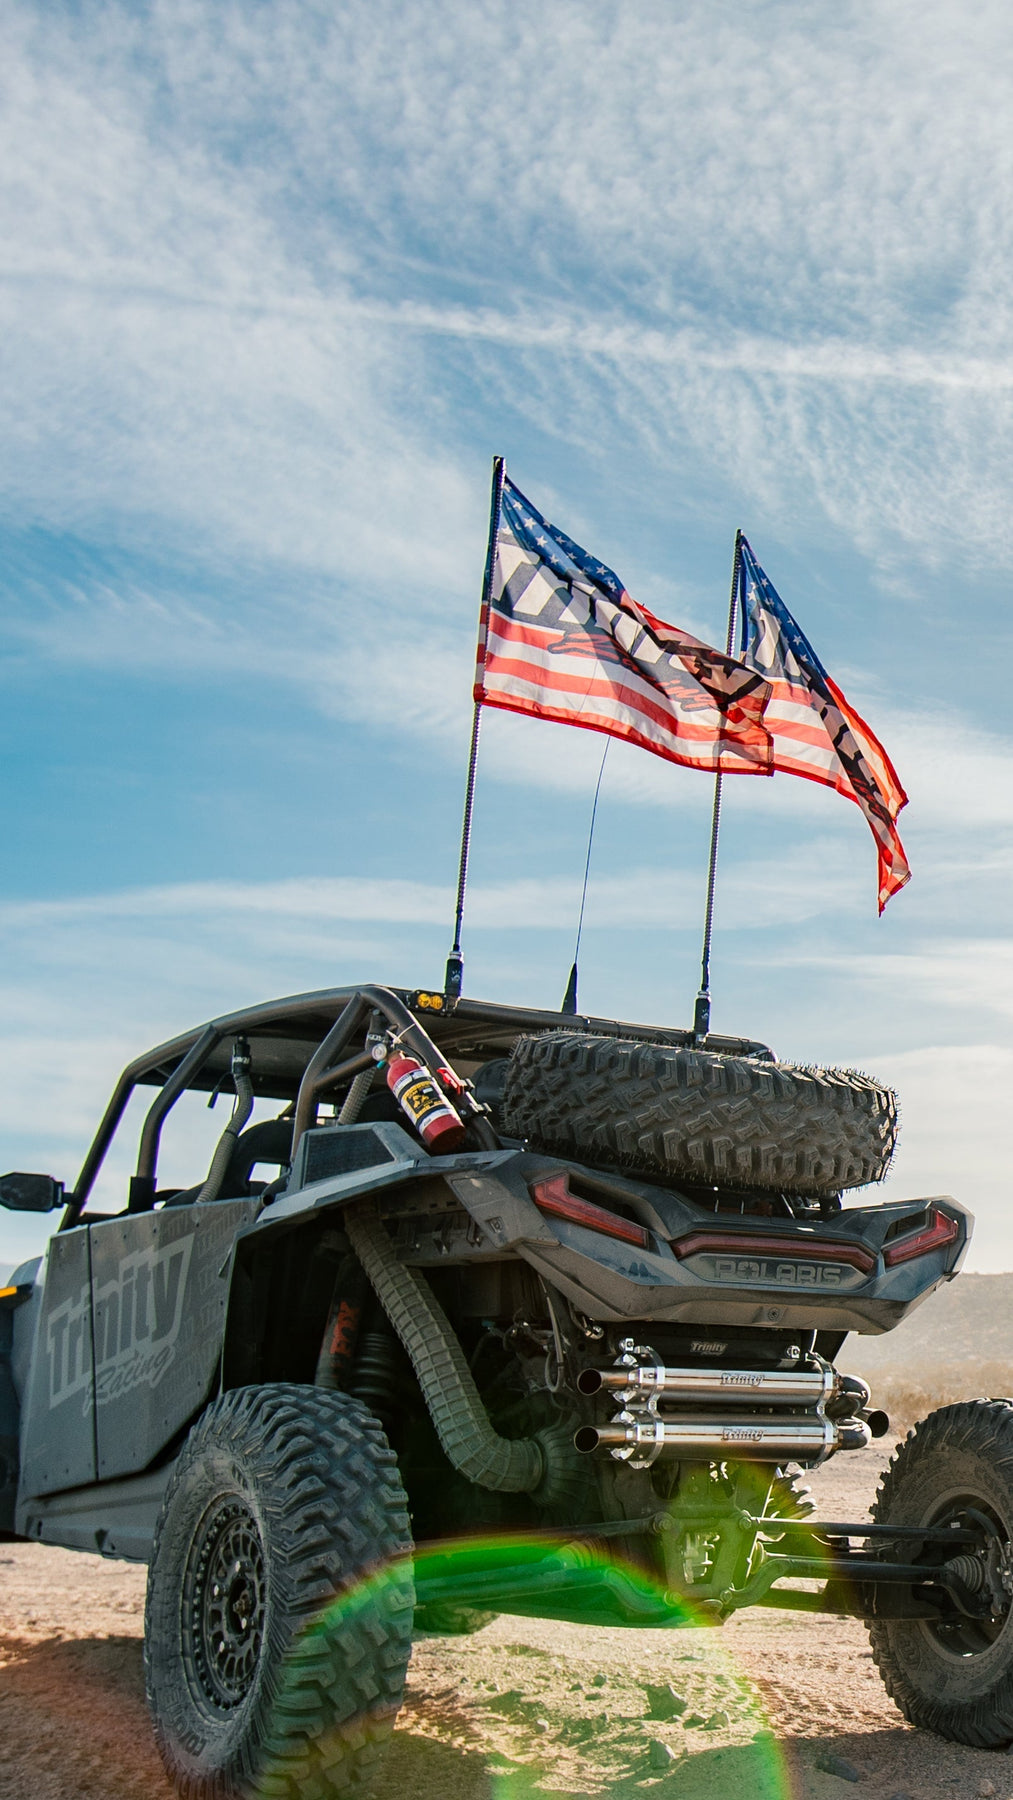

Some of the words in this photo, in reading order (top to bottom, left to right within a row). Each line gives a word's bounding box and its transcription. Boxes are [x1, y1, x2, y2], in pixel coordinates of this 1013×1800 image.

[714, 1259, 843, 1284] POLARIS
[690, 1342, 728, 1355] Trinity
[721, 1372, 765, 1387] Trinity
[722, 1427, 765, 1442] Trinity
